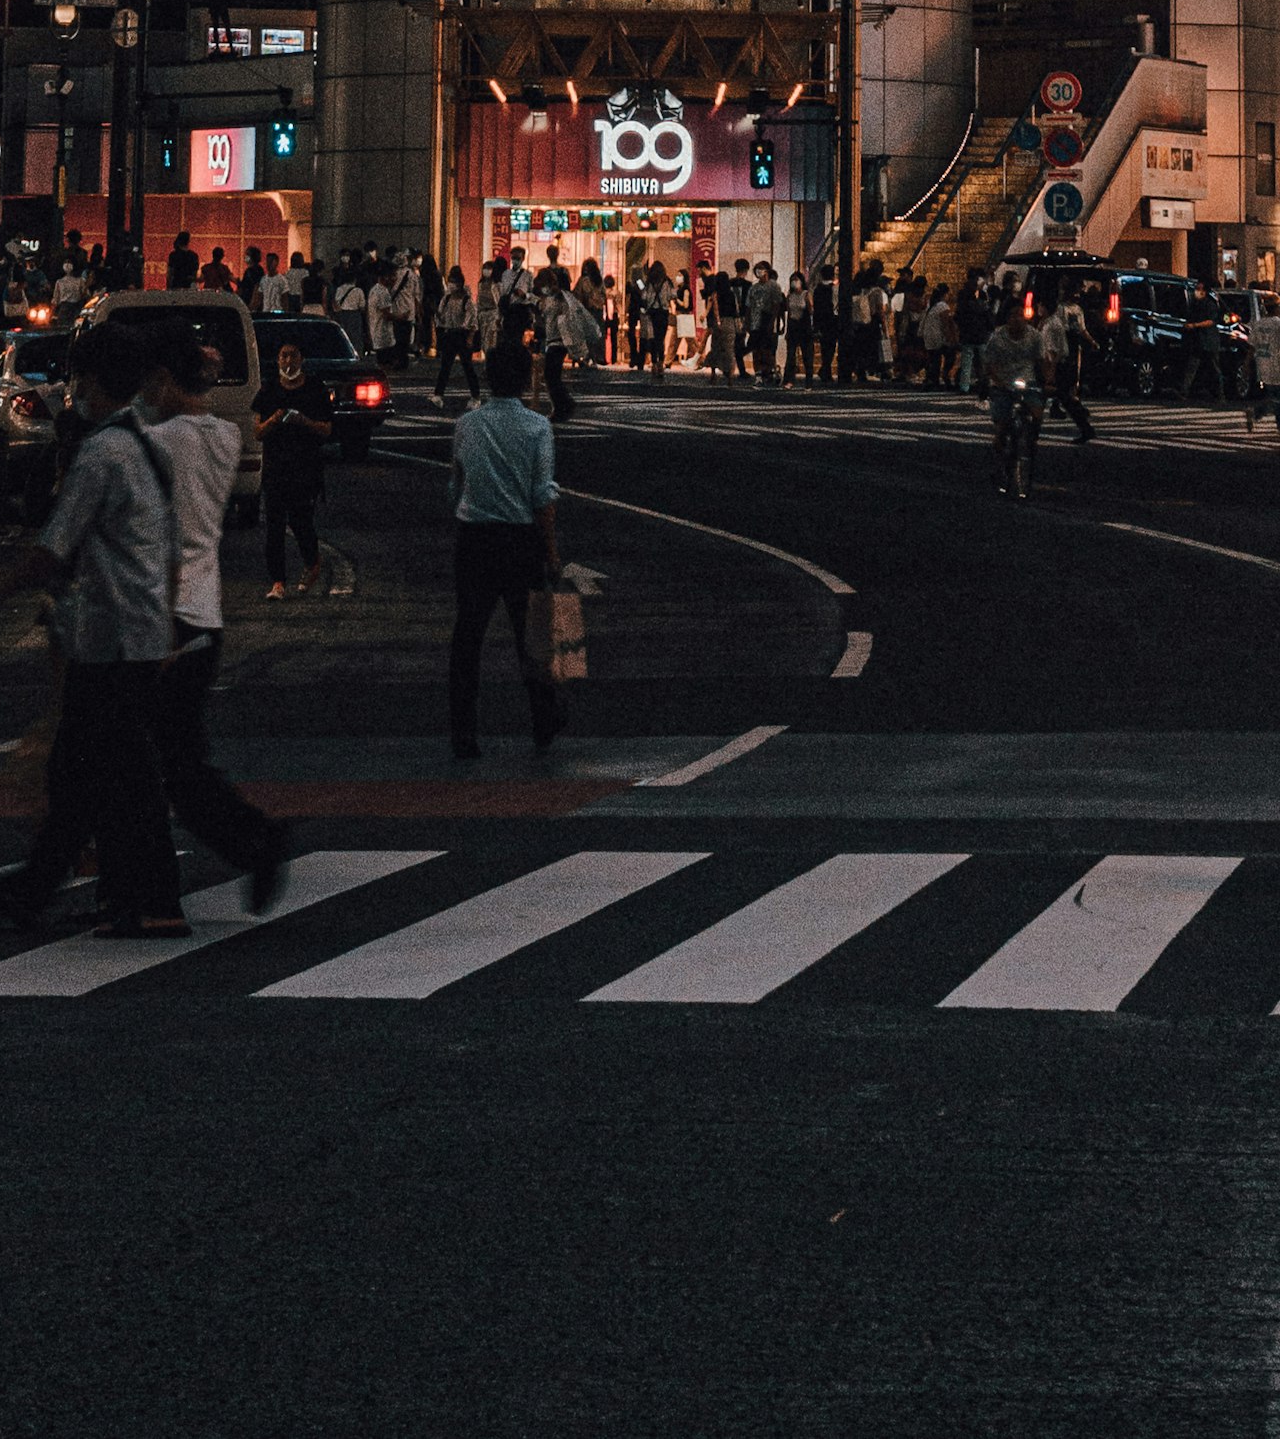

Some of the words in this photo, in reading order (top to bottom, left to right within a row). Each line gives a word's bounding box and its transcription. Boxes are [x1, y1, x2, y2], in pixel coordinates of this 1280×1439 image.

[1051, 83, 1073, 101] 30
[206, 133, 233, 186] 109
[594, 118, 694, 194] 109
[600, 177, 660, 195] SHIBUYA
